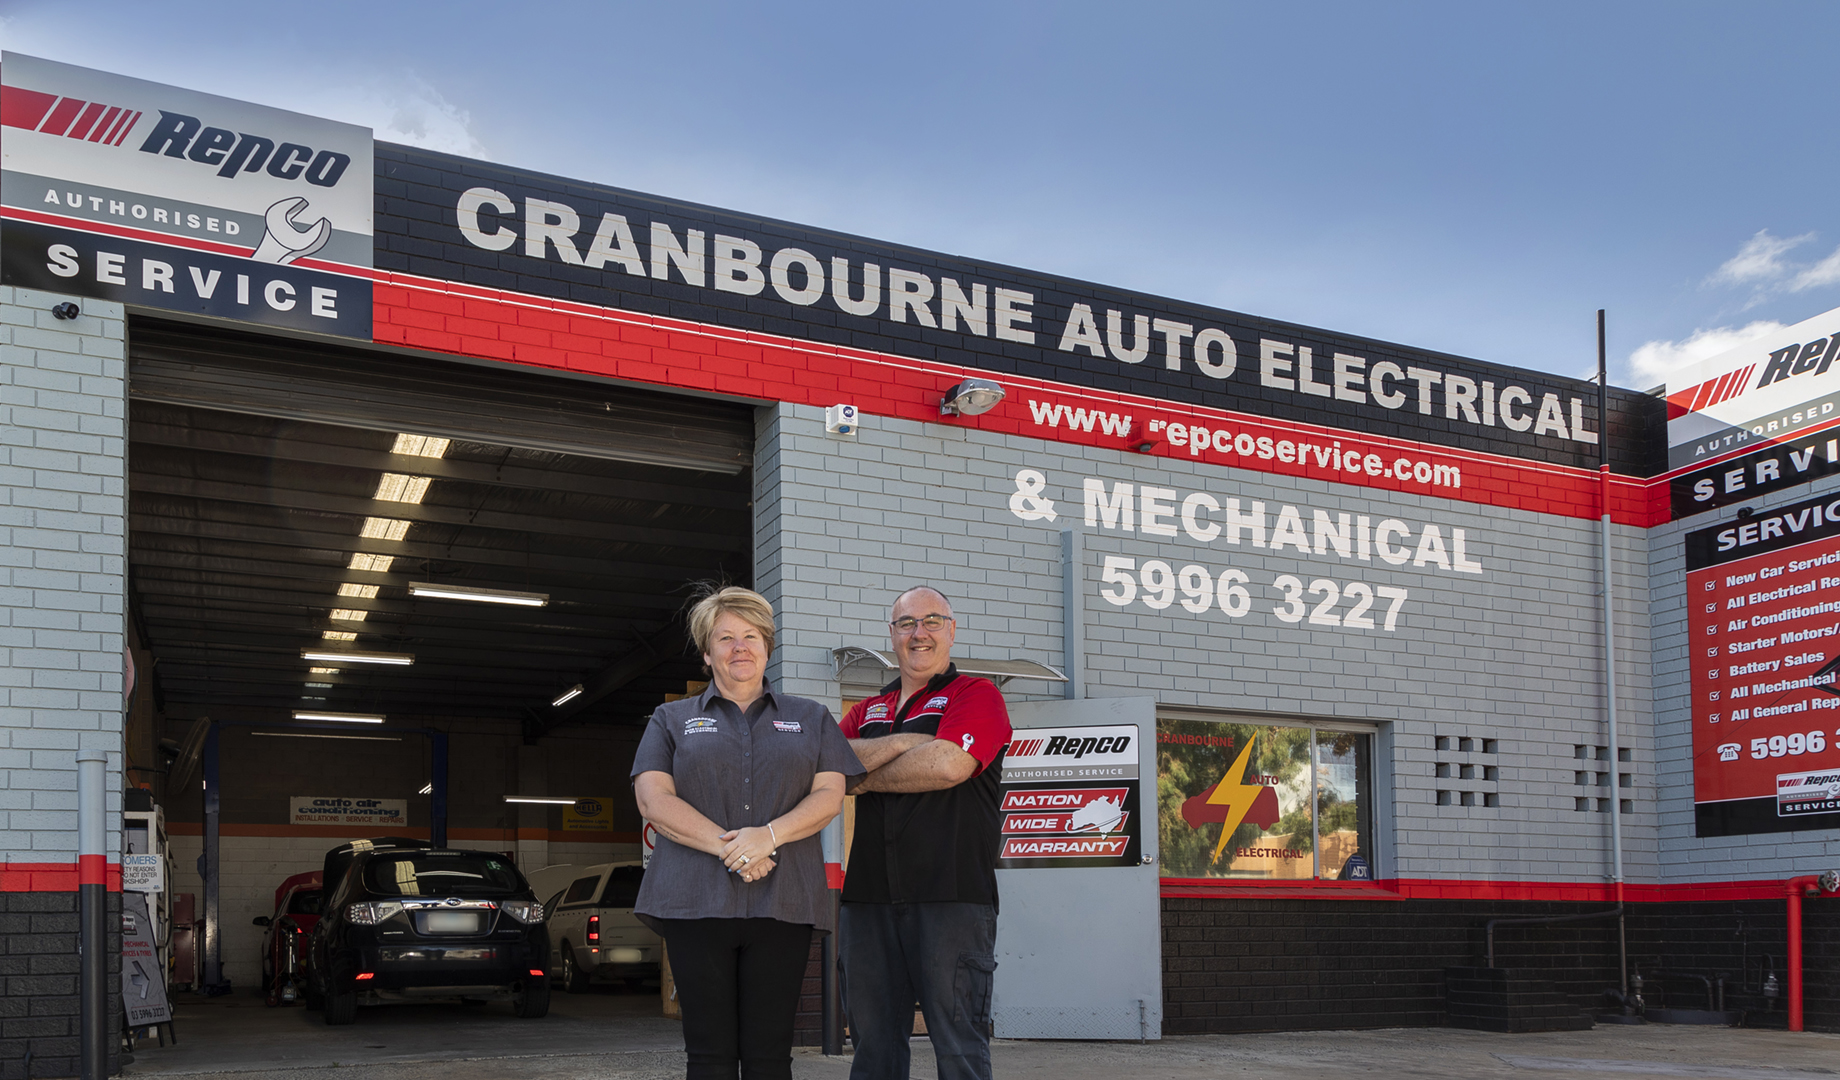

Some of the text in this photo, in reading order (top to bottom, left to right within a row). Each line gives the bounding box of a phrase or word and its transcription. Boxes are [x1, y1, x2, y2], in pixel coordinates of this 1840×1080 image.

[139, 109, 350, 187] Repco
[44, 189, 240, 235] AUTHORISED
[47, 244, 338, 318] SERVICE
[457, 187, 1598, 444] CRANBOURNE AUTO ELECTRICAL
[1695, 402, 1834, 456] AUTHORISED
[1693, 439, 1838, 502] SERVI
[1009, 469, 1483, 574] & MECHANICAL
[1726, 572, 1757, 587] New
[1760, 566, 1785, 579] Car
[1101, 555, 1408, 632] 5996 3227
[1726, 577, 1840, 609] All Electrical Re
[1727, 601, 1840, 632] Air Conditioning
[1728, 623, 1840, 654] Starter Motors/
[1729, 652, 1825, 677] Battery Sales
[1730, 672, 1836, 699] All Mechanical
[1731, 697, 1840, 721] All General Rep
[1043, 736, 1131, 759] Repco
[1156, 733, 1234, 747] CRANBOURNE
[1751, 730, 1826, 759] 5996
[1007, 768, 1123, 778] AUTHORISED SERVICE
[1250, 775, 1279, 785] AUTO
[313, 799, 352, 807] auto
[1008, 794, 1083, 806] NATION
[298, 807, 400, 817] conditioning
[379, 816, 404, 824] REPAIRS
[1009, 818, 1058, 829] WIDE
[1010, 841, 1123, 853] WARRANTY
[1236, 848, 1303, 859] ELECTRICAL
[123, 856, 157, 865] OMERS
[1351, 866, 1367, 877] ADT
[131, 1007, 165, 1020] 03 5996 3227
